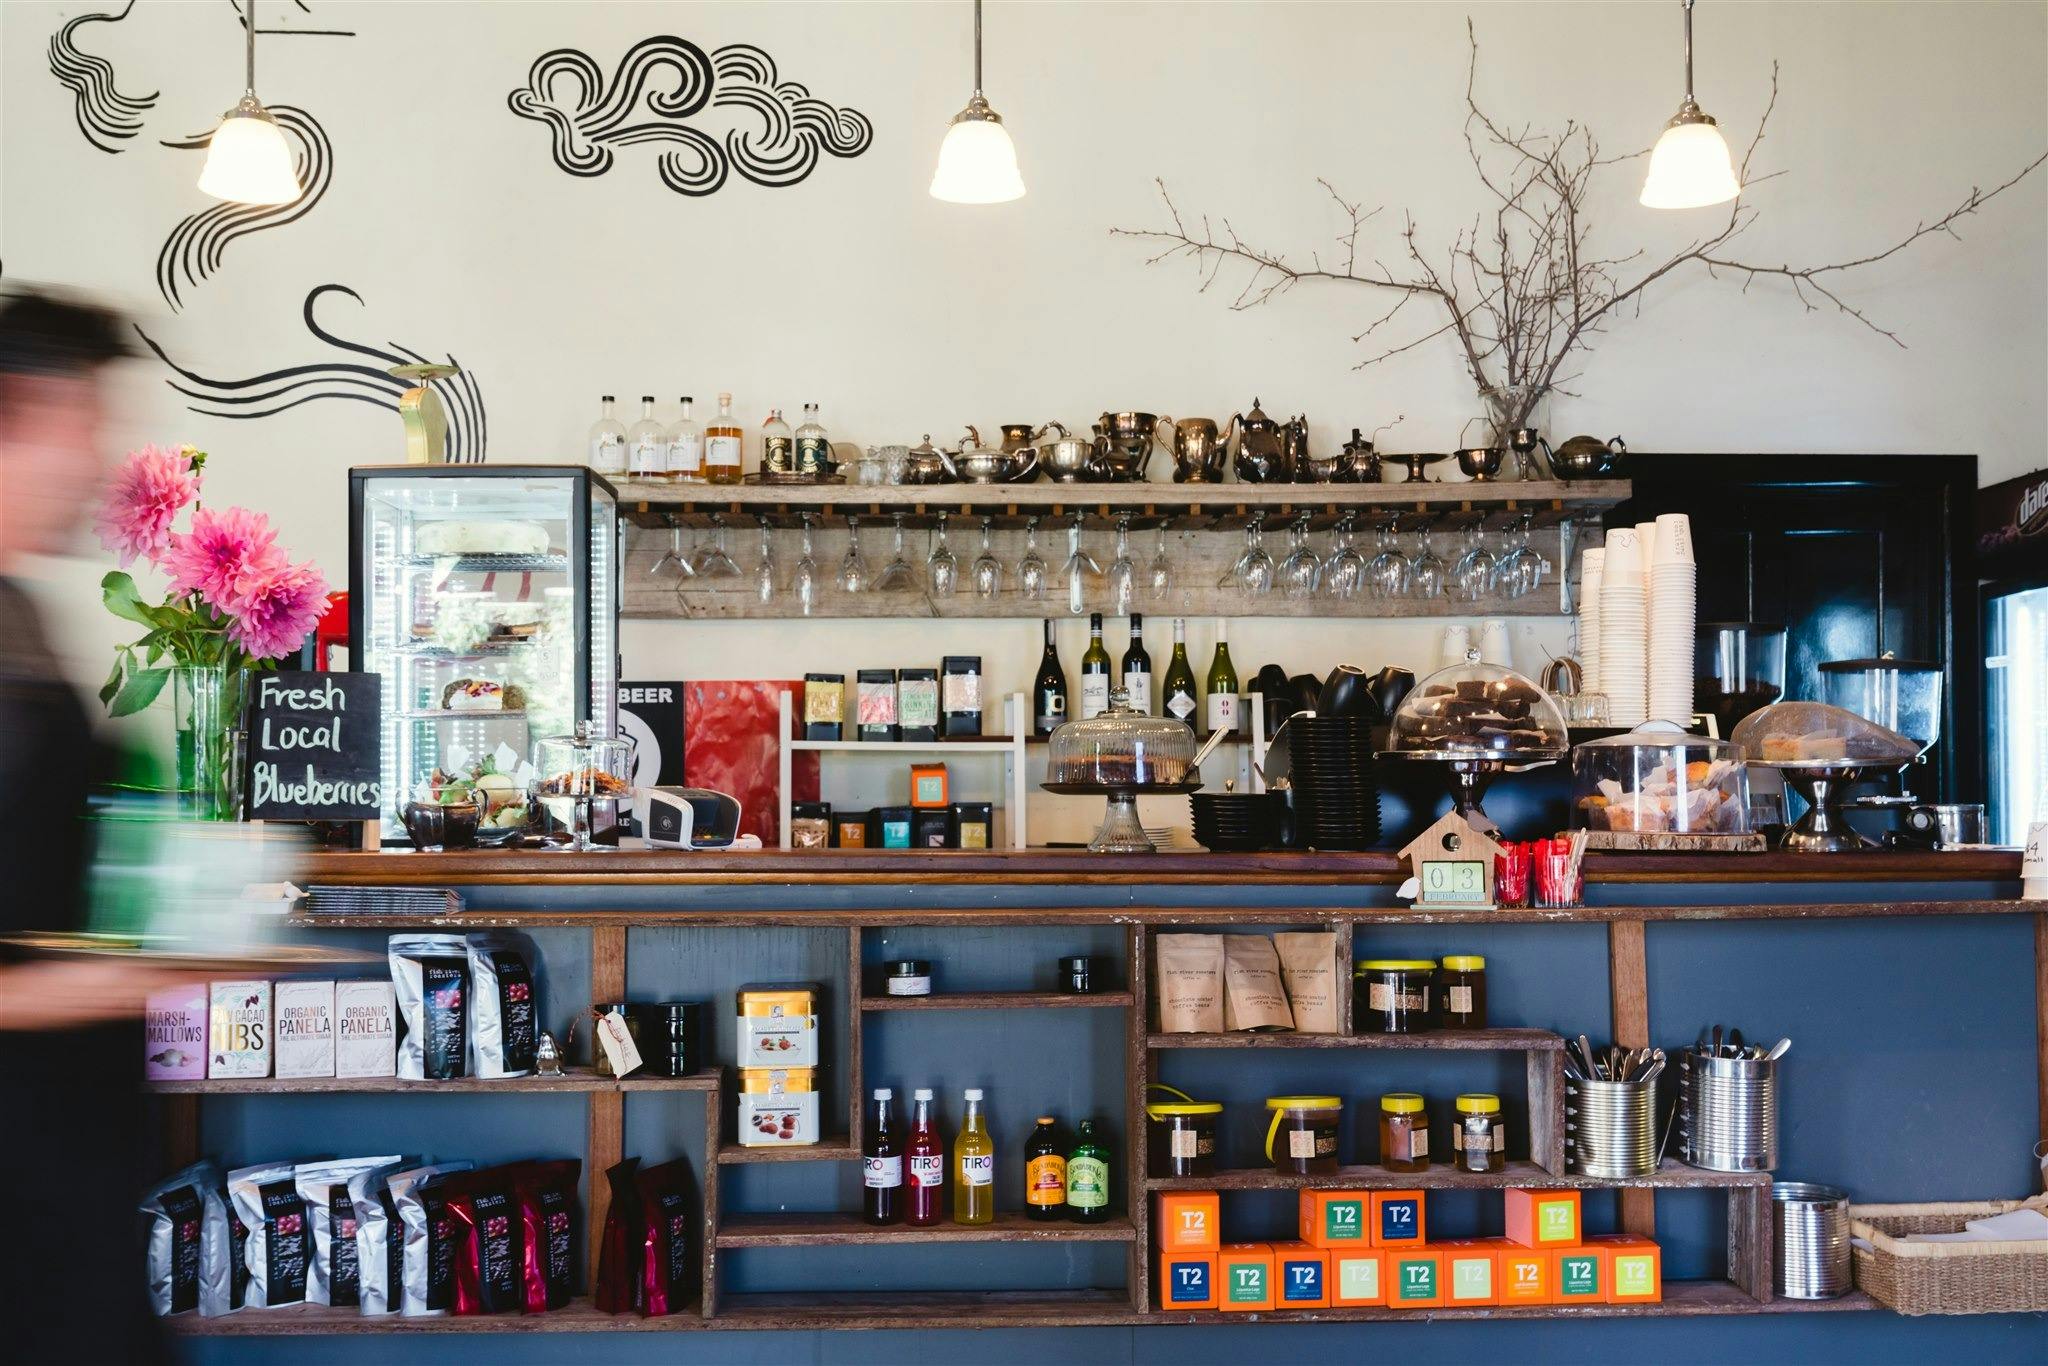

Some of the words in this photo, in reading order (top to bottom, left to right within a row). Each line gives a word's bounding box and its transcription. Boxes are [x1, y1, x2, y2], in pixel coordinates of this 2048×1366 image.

[260, 677, 346, 711] Fresh
[618, 688, 673, 703] BEER
[262, 716, 341, 752] Local
[253, 761, 381, 809] Blueberries
[923, 782, 938, 792] T2
[846, 828, 860, 839] T2
[1430, 893, 1480, 901] FEBRUARY
[148, 1011, 191, 1027] MARSH-
[235, 1009, 265, 1022] CACAO
[284, 1006, 327, 1019] ORGANIC
[345, 1006, 388, 1019] ORGANIC
[279, 1018, 331, 1035] PANELA
[341, 1017, 392, 1034] PANELA
[147, 1027, 202, 1043] MALLOWS
[212, 1023, 264, 1051] NIBS
[865, 1158, 883, 1170] RO
[911, 1156, 940, 1169] TIRO
[963, 1156, 992, 1169] TIRO
[1182, 1212, 1205, 1228] T2
[1333, 1206, 1356, 1223] T2
[1389, 1206, 1411, 1222] T2
[1546, 1207, 1568, 1224] T2
[1178, 1268, 1202, 1285] T2
[1236, 1269, 1260, 1286] T2
[1291, 1267, 1315, 1284] T2
[1347, 1266, 1370, 1282] T2
[1406, 1266, 1430, 1283] T2
[1461, 1265, 1484, 1282] T2
[1515, 1264, 1538, 1281] T2
[1568, 1263, 1592, 1279] T2
[1624, 1262, 1647, 1279] T2
